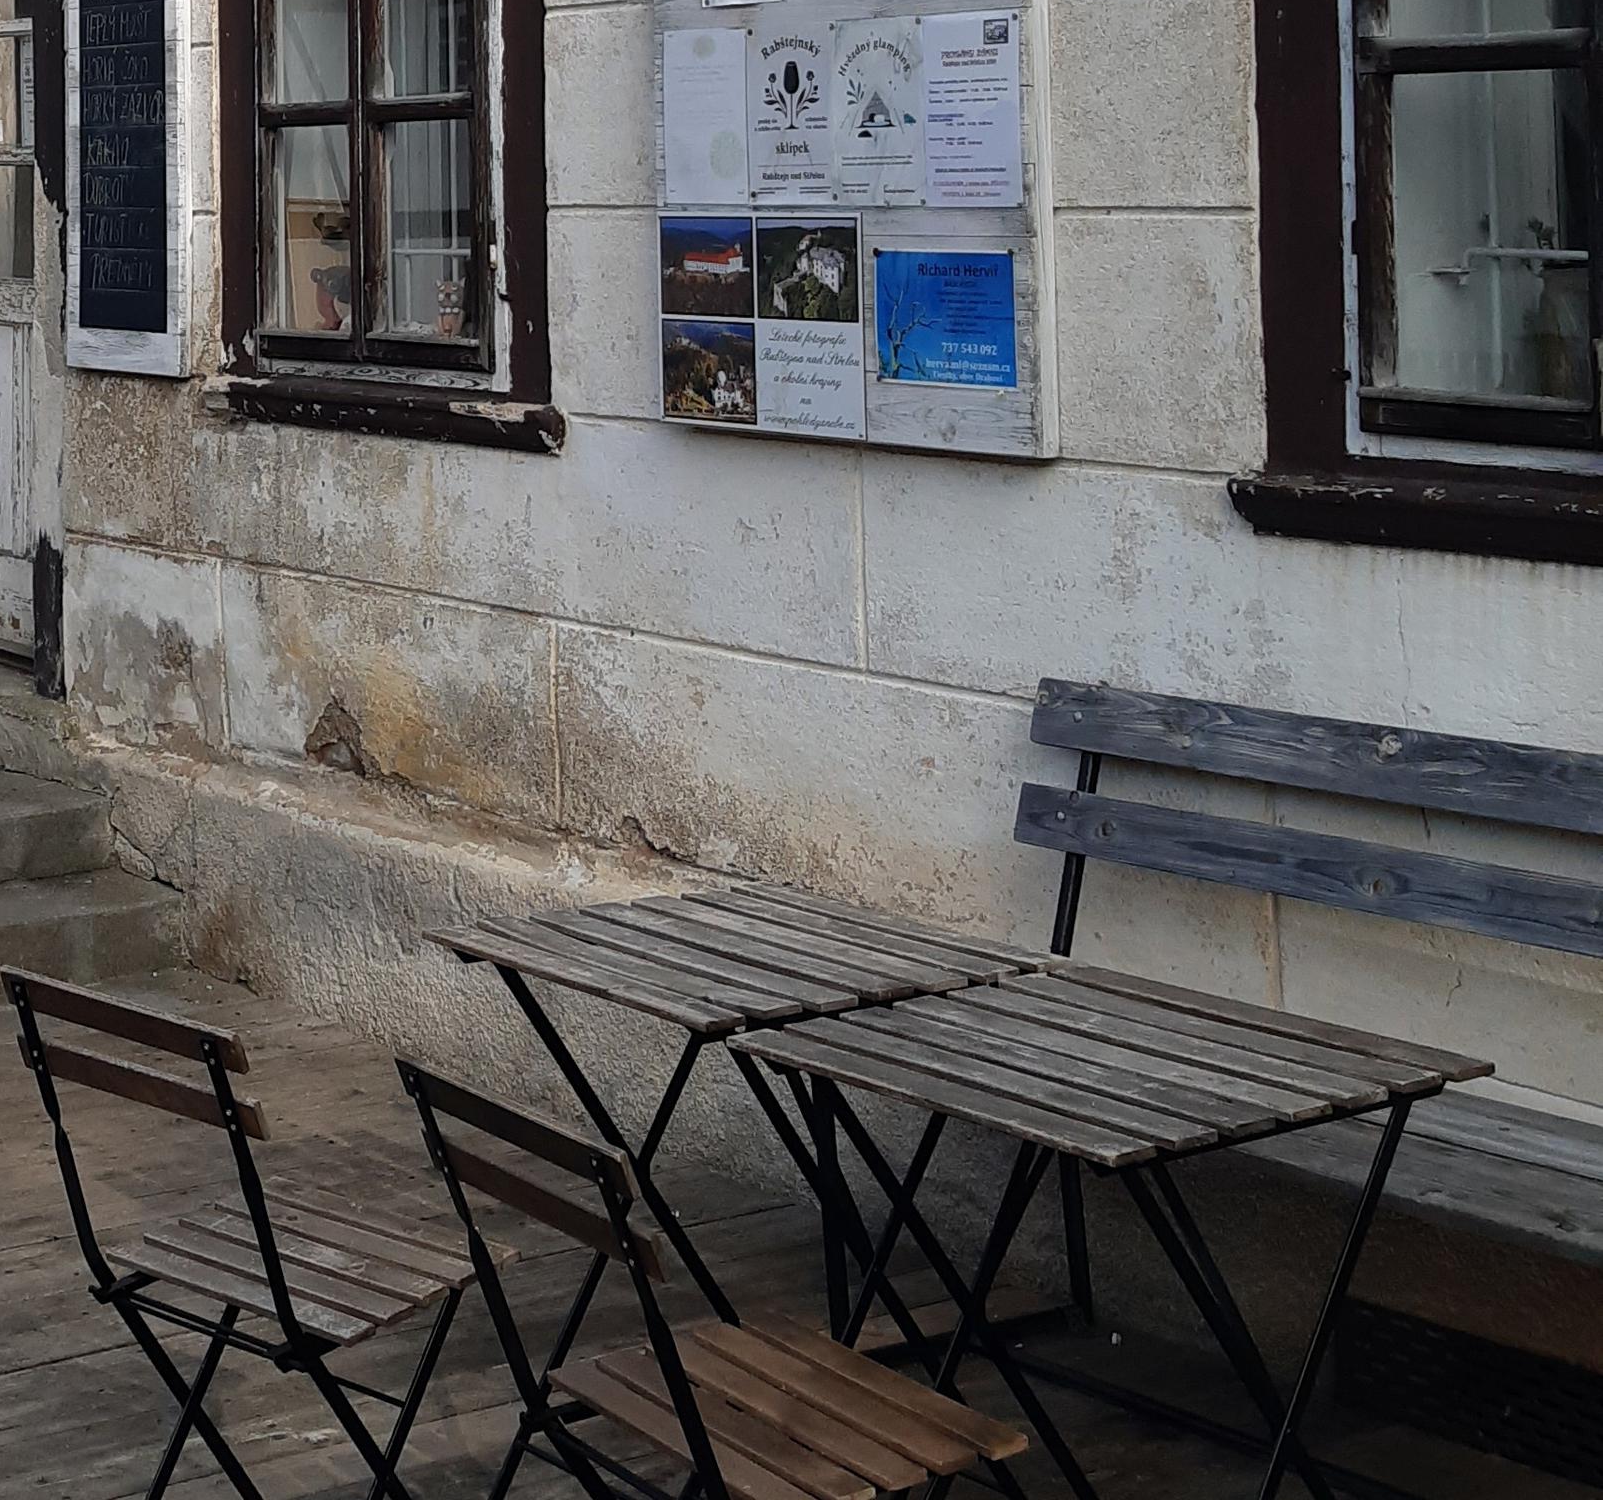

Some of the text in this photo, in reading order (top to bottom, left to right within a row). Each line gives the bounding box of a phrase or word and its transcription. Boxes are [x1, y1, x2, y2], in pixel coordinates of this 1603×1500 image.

[760, 35, 821, 60] Rabštejnský
[918, 263, 960, 276] Richard
[941, 342, 958, 353] 737
[961, 343, 978, 354] 543
